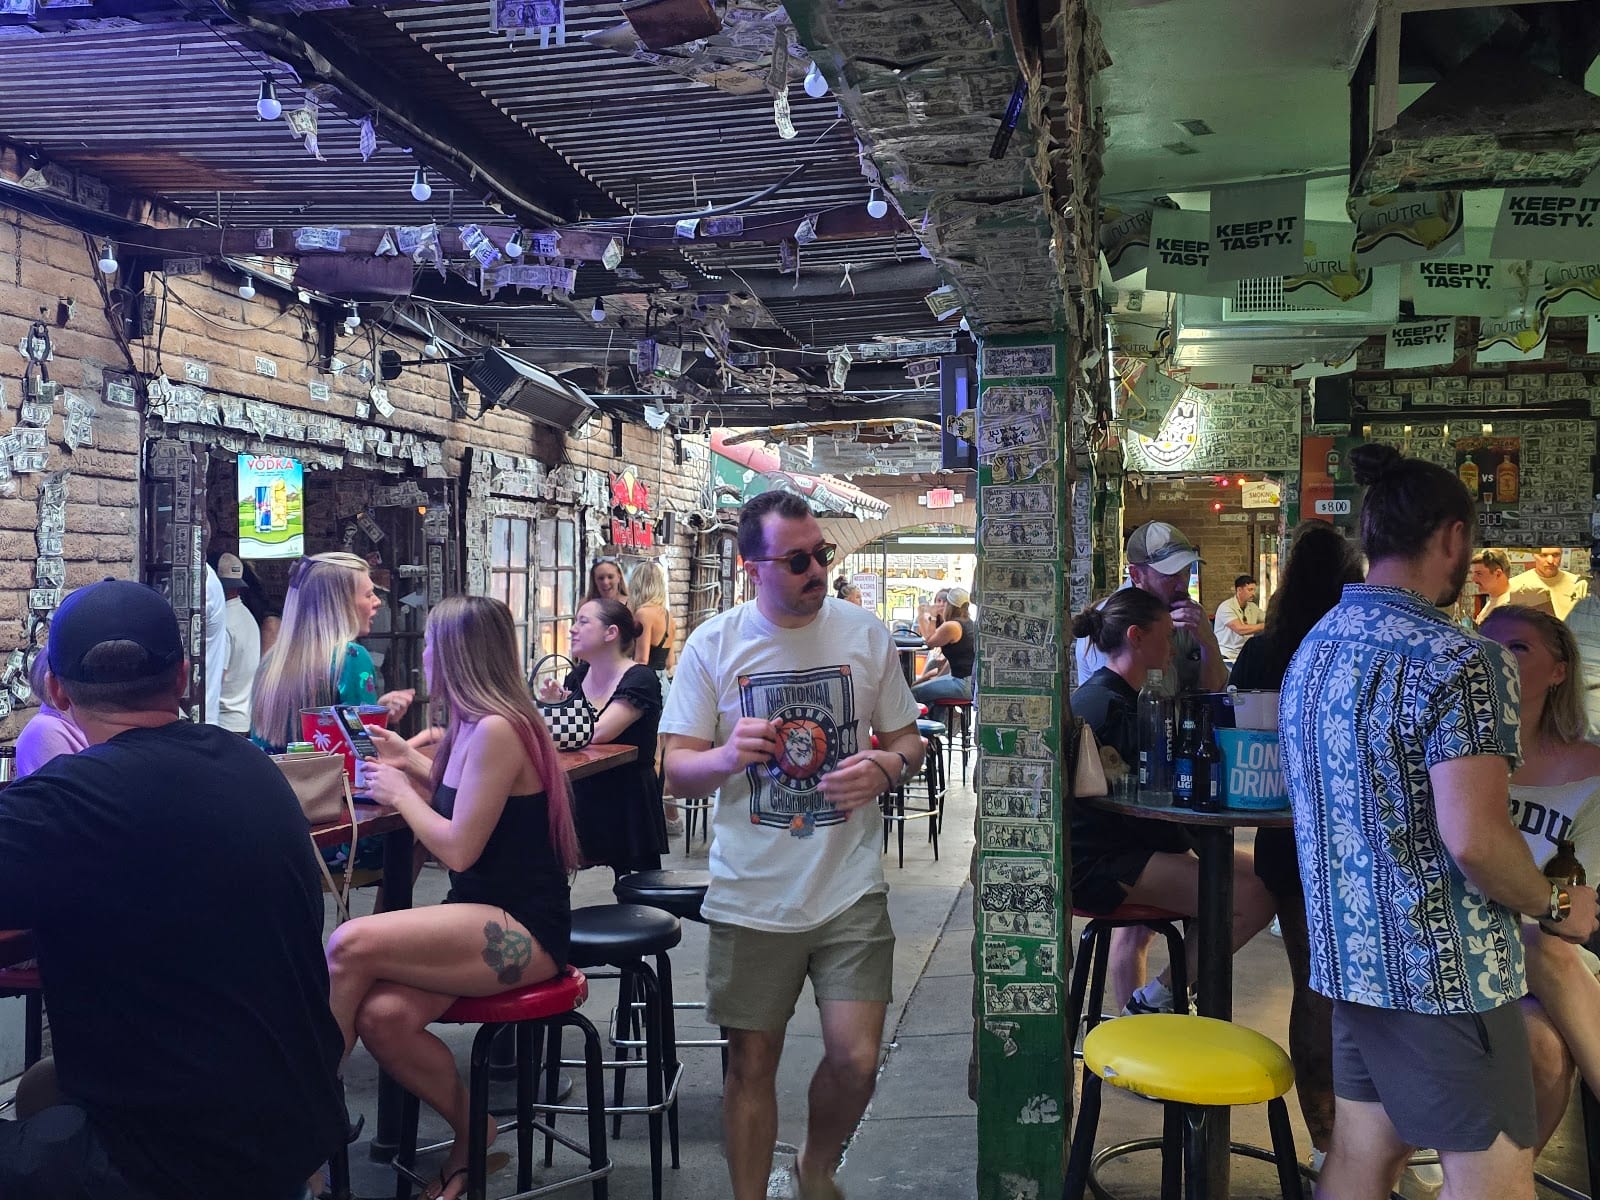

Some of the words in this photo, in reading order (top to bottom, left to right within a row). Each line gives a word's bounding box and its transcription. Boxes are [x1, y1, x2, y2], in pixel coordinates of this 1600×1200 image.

[1509, 196, 1577, 211] KEEP
[1579, 197, 1600, 212] IT
[1216, 220, 1273, 239] KEEP
[1276, 216, 1297, 231] IT
[1511, 211, 1594, 228] TASTY.
[1156, 237, 1210, 253] KEEP
[1219, 231, 1293, 251] TASTY.
[1159, 251, 1210, 267] TAST
[1420, 262, 1474, 276] KEEP
[1476, 264, 1494, 277] IT
[1423, 275, 1491, 290] TASTY.
[1391, 325, 1433, 338] KEEP
[1435, 323, 1450, 334] IT
[1394, 334, 1447, 348] TASTY.
[247, 460, 293, 470] VODKA
[764, 682, 834, 715] NATIONAL
[785, 707, 826, 722] CONN
[1164, 717, 1172, 761] smart
[1236, 740, 1281, 770] LON
[1177, 781, 1193, 789] LIG
[1181, 774, 1193, 782] BU
